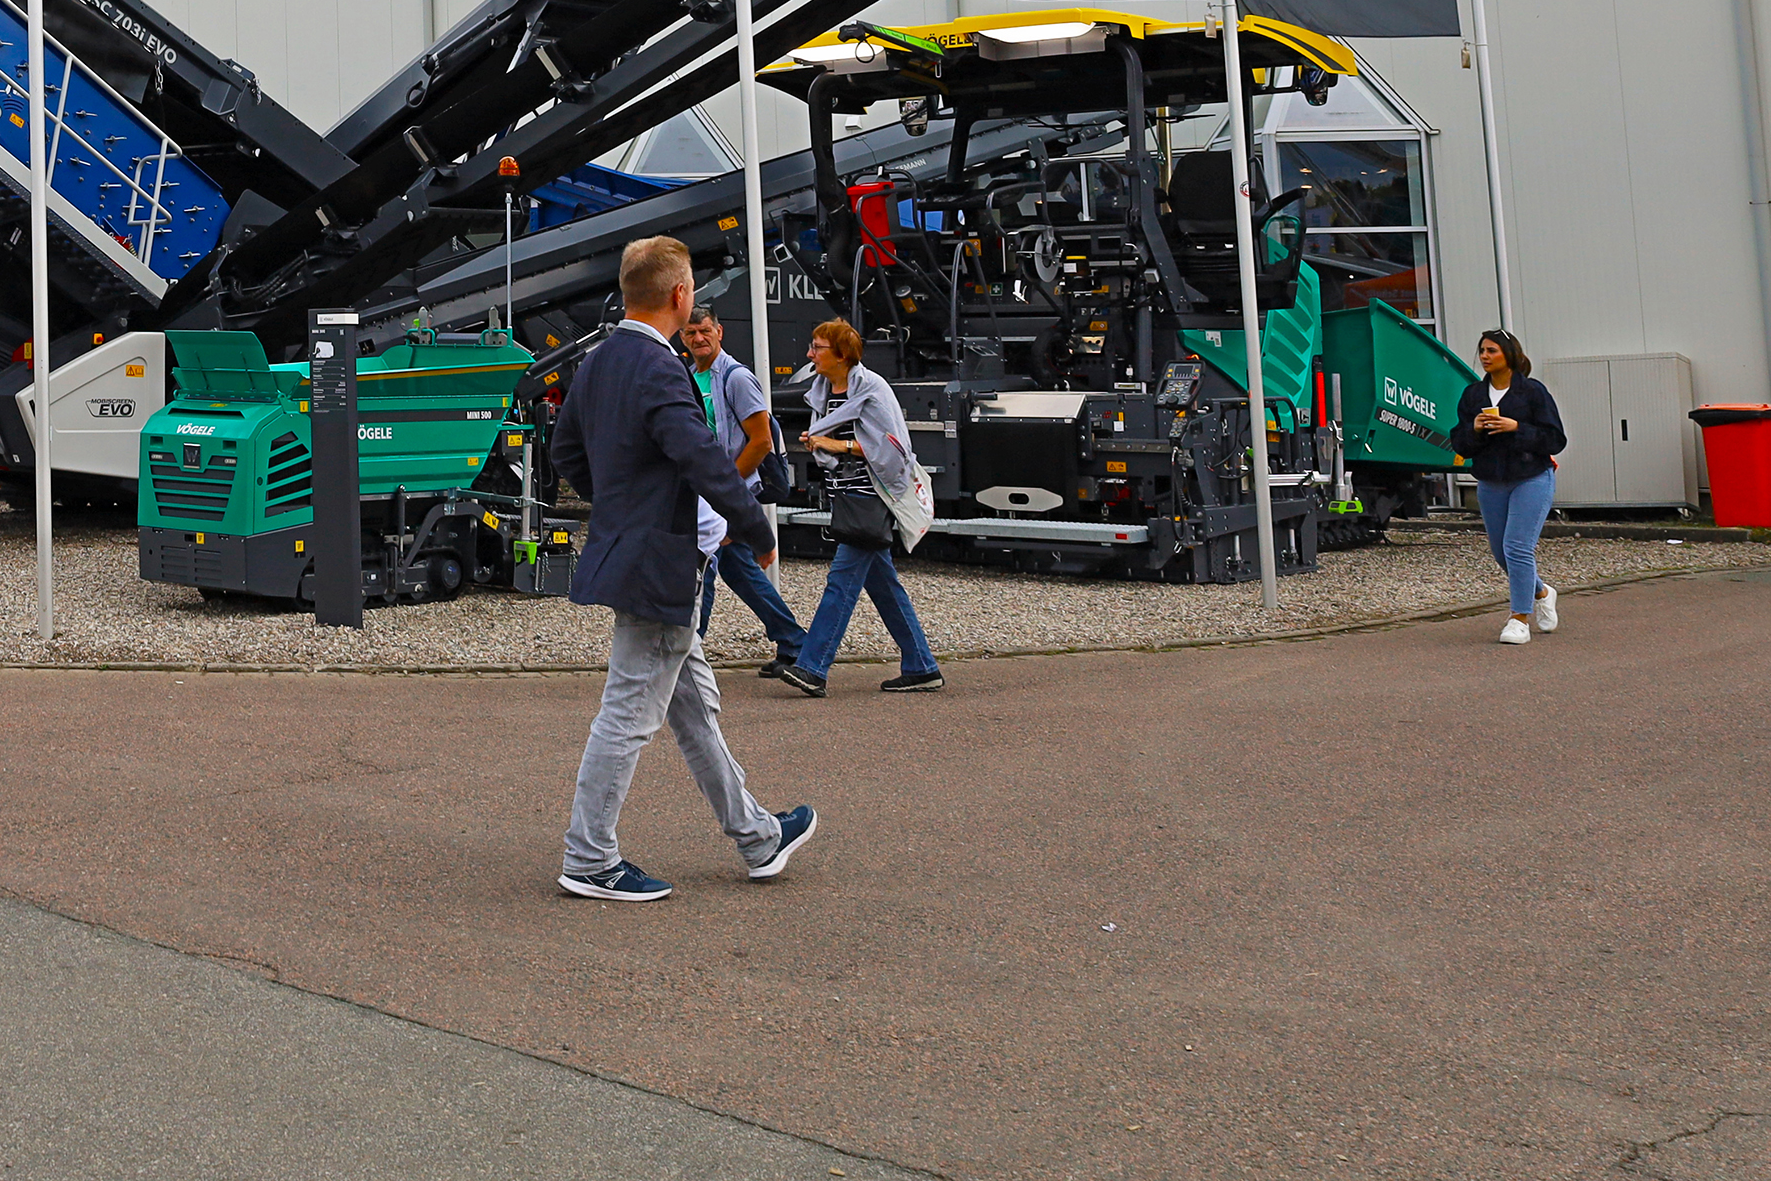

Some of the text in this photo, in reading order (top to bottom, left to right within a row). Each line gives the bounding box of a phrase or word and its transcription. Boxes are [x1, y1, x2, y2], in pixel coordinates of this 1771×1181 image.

[113, 8, 147, 41] 703i
[144, 34, 177, 65] EVO
[925, 33, 970, 46] ÖGEL
[99, 404, 132, 416] EVO
[1399, 386, 1436, 420] VÖGELE
[466, 411, 492, 419] MINI 500
[1379, 409, 1398, 426] SUPER
[176, 423, 216, 436] VÖGELE
[357, 424, 393, 440] ÖGELE
